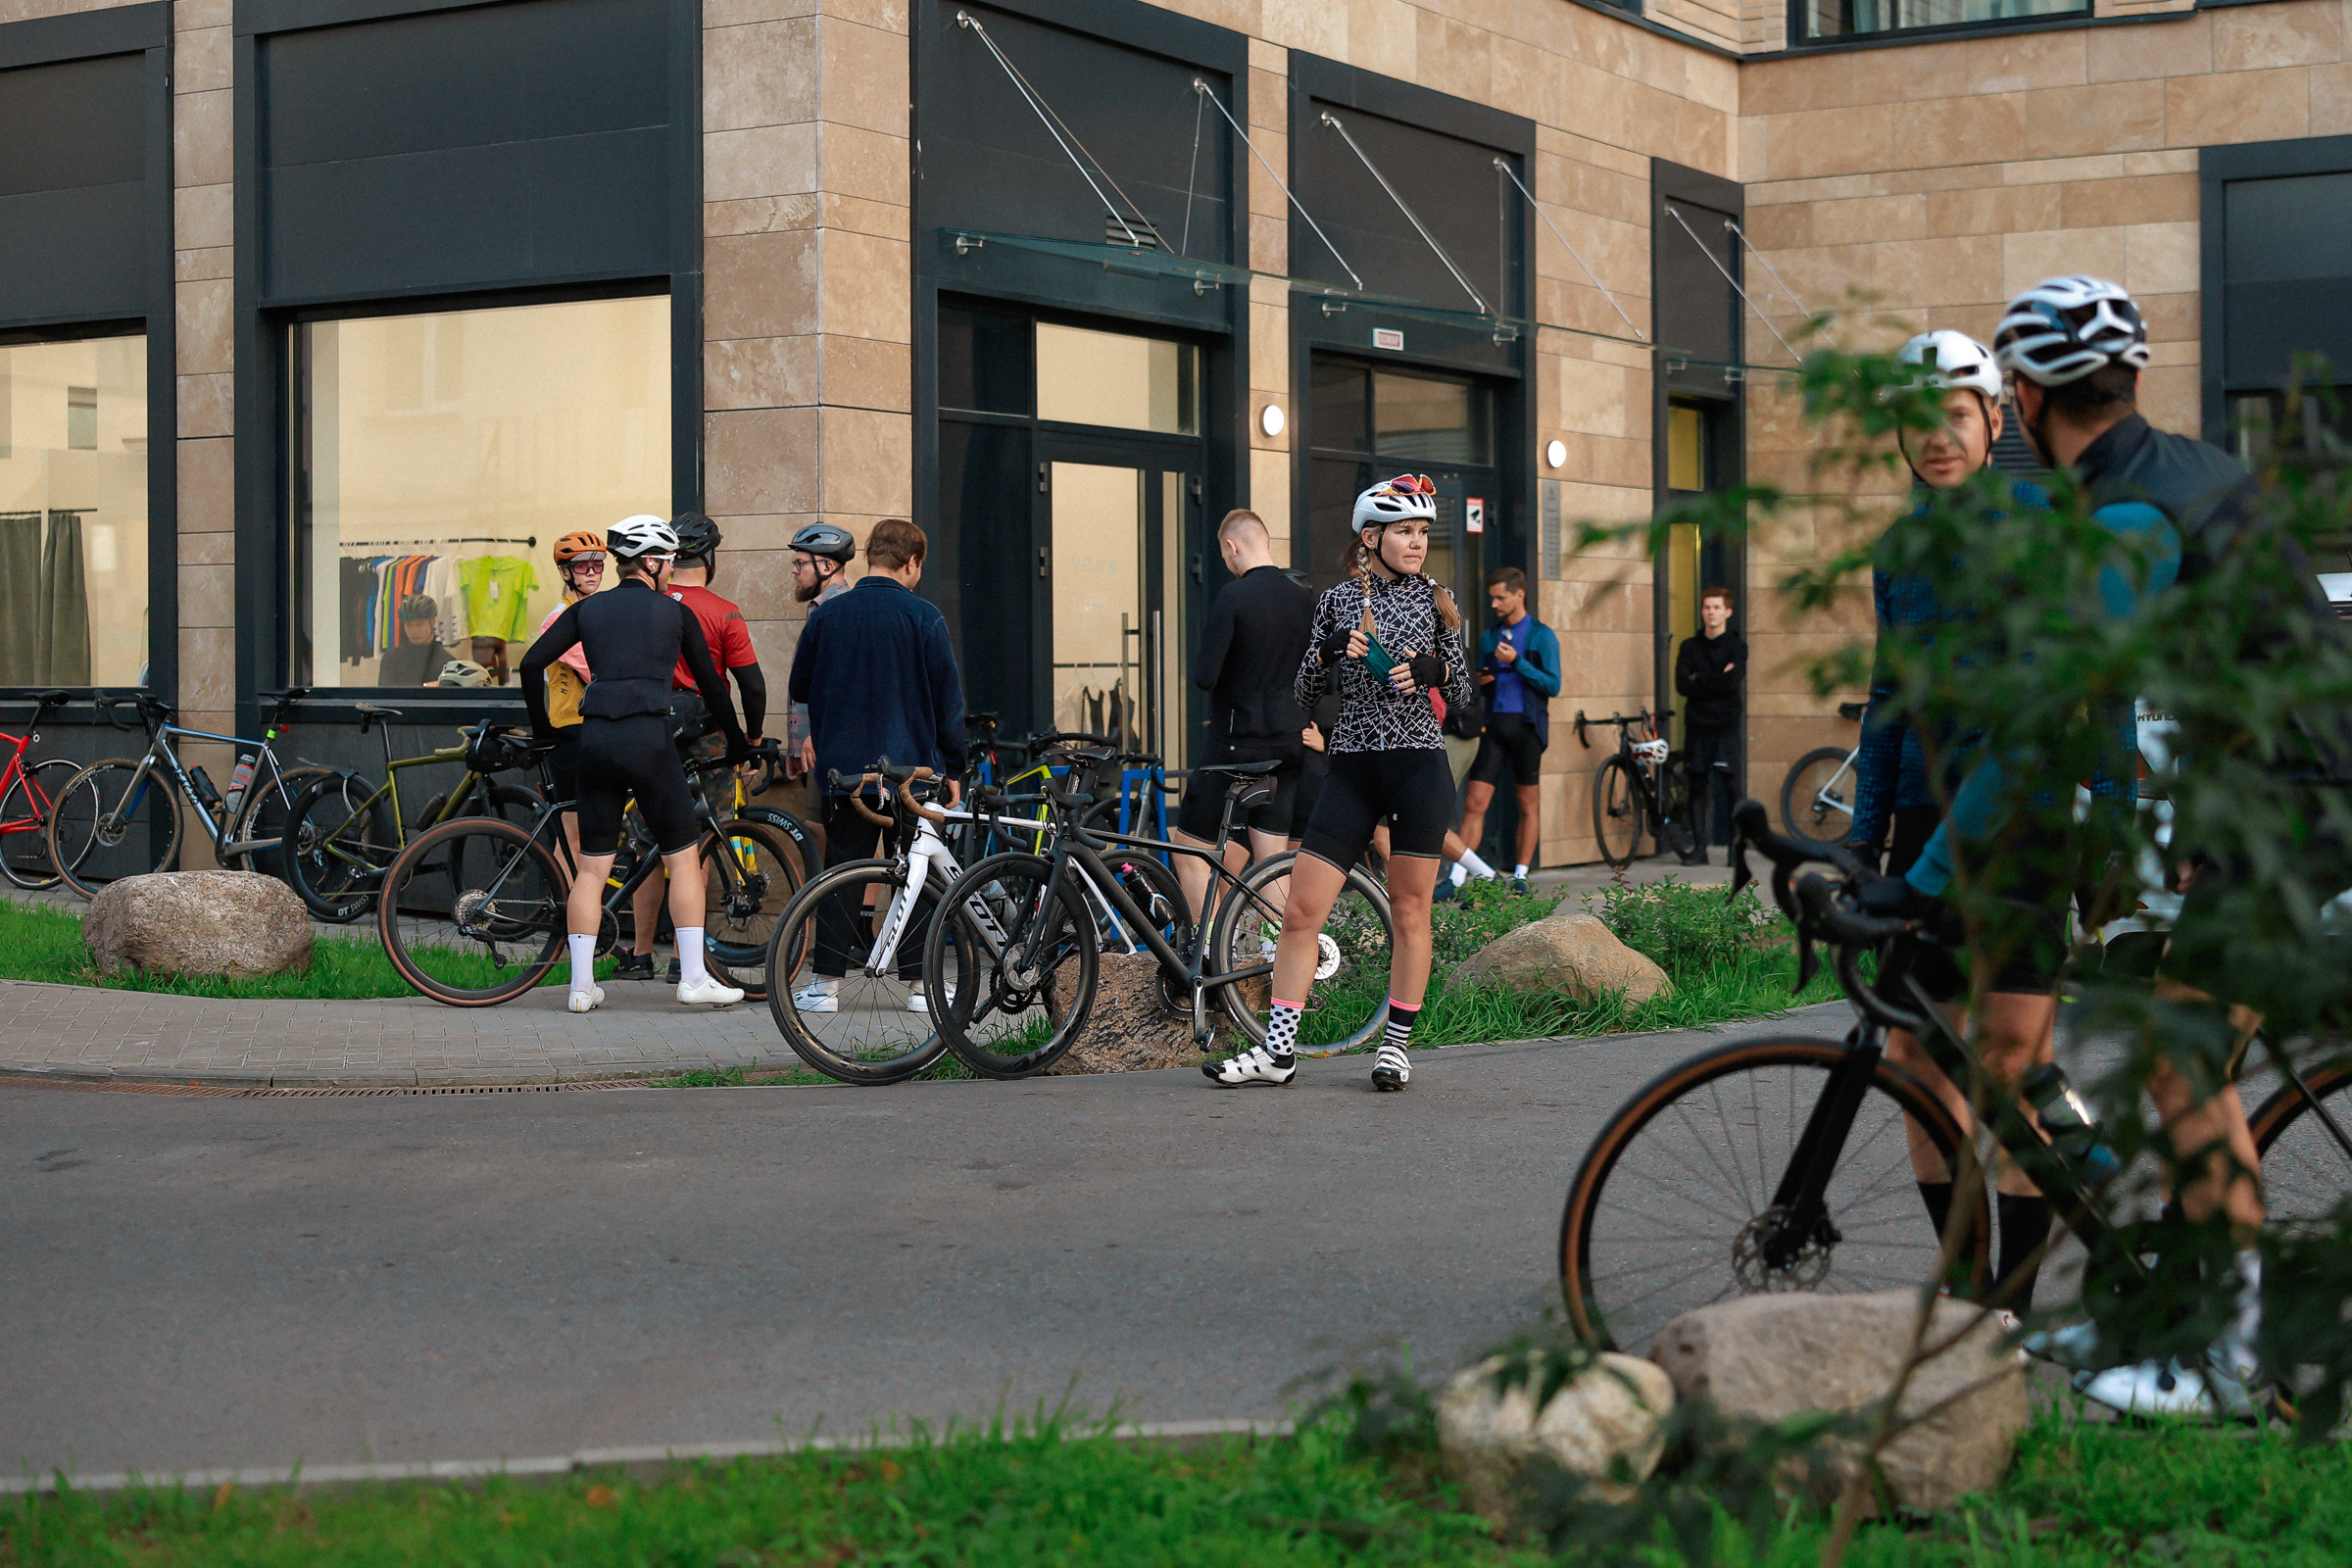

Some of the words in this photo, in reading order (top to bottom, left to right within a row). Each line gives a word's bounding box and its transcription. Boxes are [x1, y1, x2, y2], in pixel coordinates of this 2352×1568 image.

[767, 812, 793, 830] SWISS
[789, 828, 805, 842] DT
[337, 906, 350, 917] DT
[350, 893, 369, 913] SWISS
[943, 865, 1007, 948] SOTT
[887, 883, 910, 952] SCOTT
